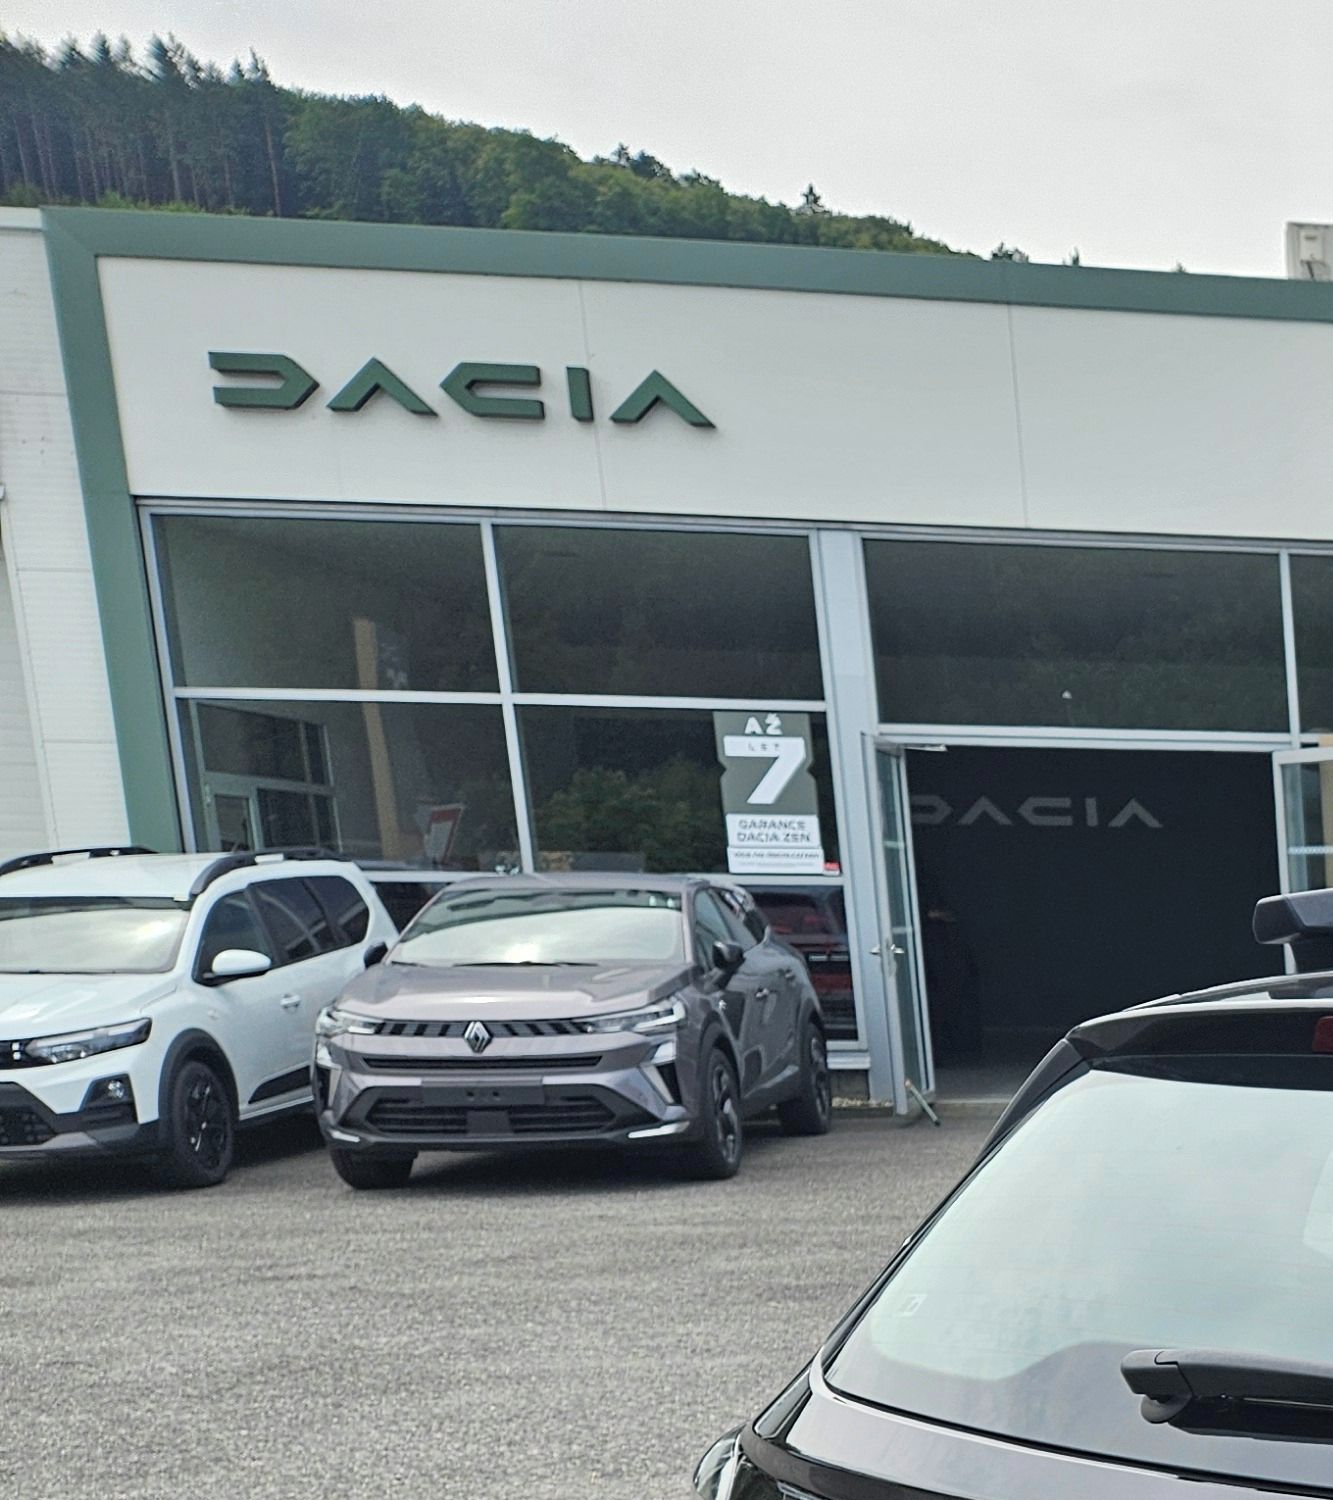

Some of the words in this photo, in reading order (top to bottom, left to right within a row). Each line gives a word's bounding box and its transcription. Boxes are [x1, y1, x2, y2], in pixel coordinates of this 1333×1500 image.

[208, 351, 717, 429] DACIA
[723, 735, 807, 805] 7
[737, 832, 780, 843] DACIA
[911, 794, 1164, 829] DACIA
